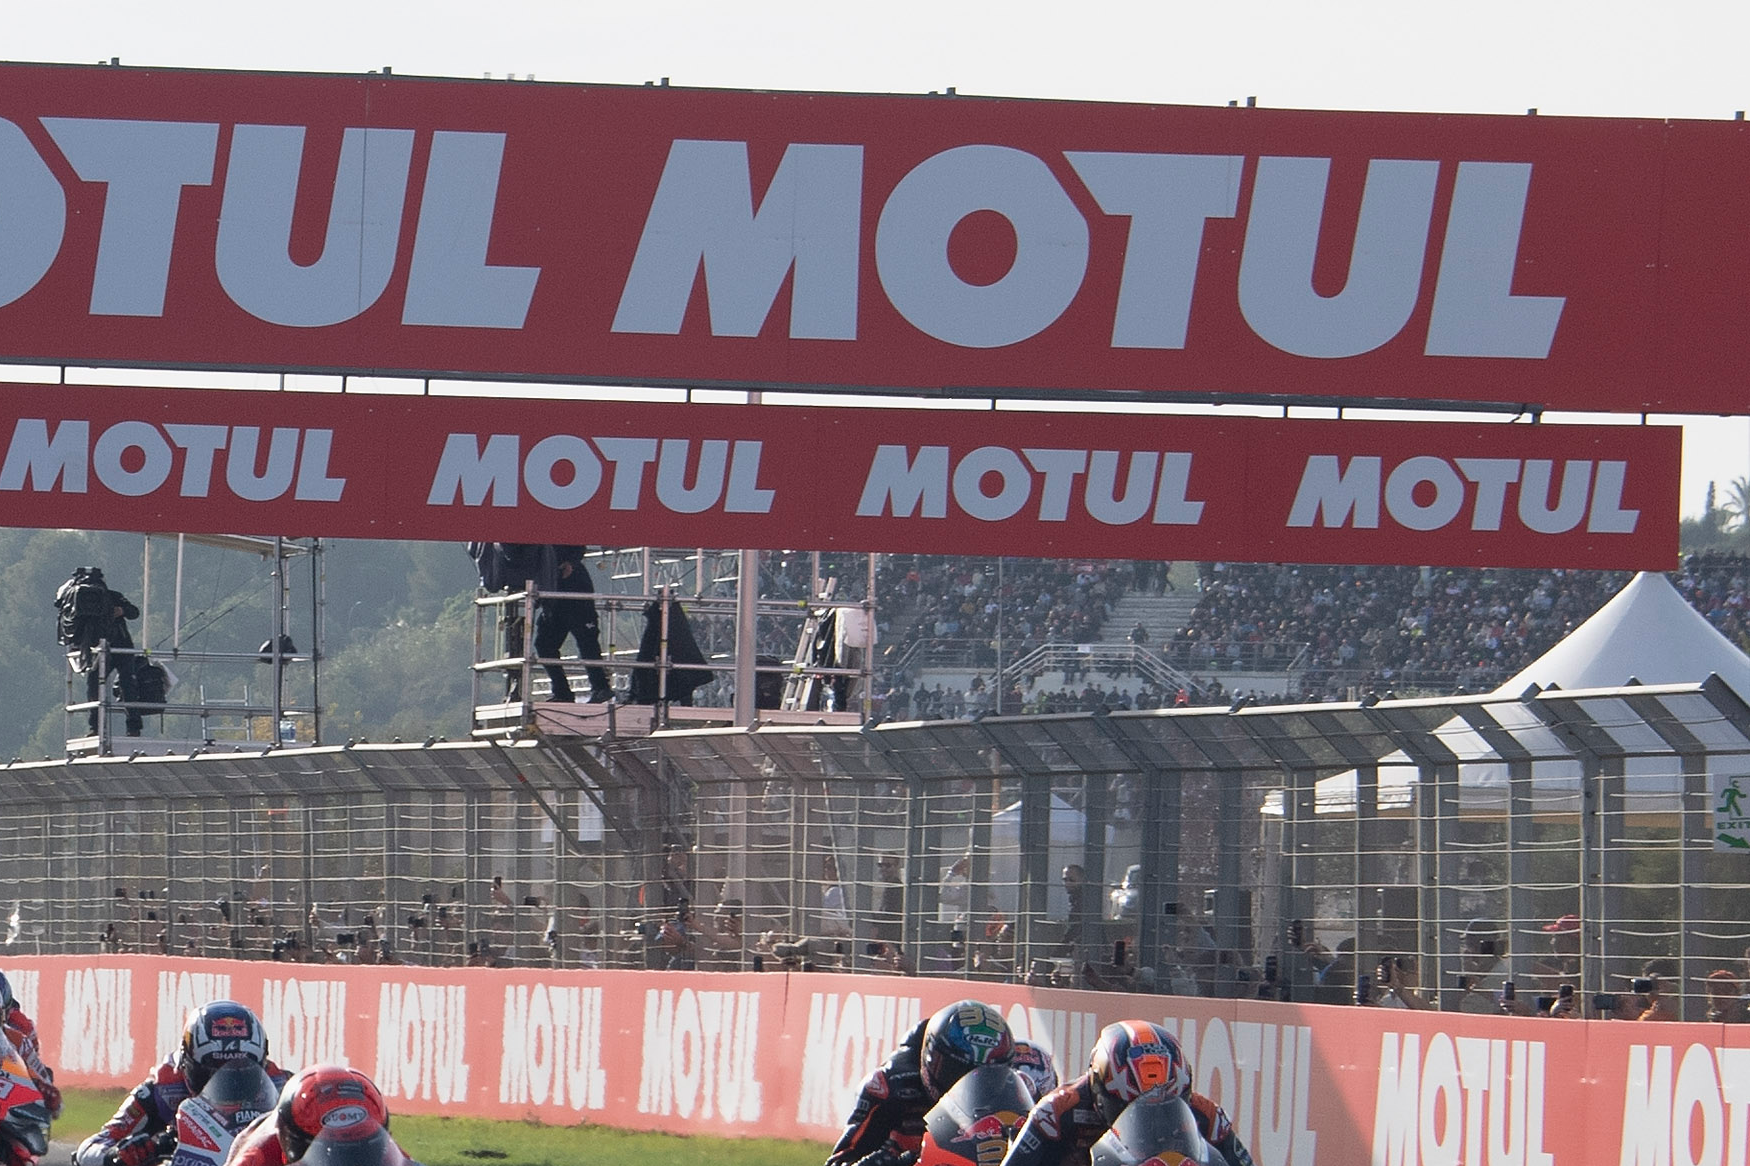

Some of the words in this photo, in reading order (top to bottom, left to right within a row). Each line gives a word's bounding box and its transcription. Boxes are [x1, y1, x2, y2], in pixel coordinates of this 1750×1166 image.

[611, 140, 1565, 358] MOTUL
[427, 434, 775, 513] MOTUL
[856, 445, 1204, 524] MOTUL
[1287, 456, 1639, 533] MOTUL
[375, 982, 468, 1104] MOTUL
[499, 983, 605, 1110] MOTUL
[638, 988, 762, 1123] MOTUL
